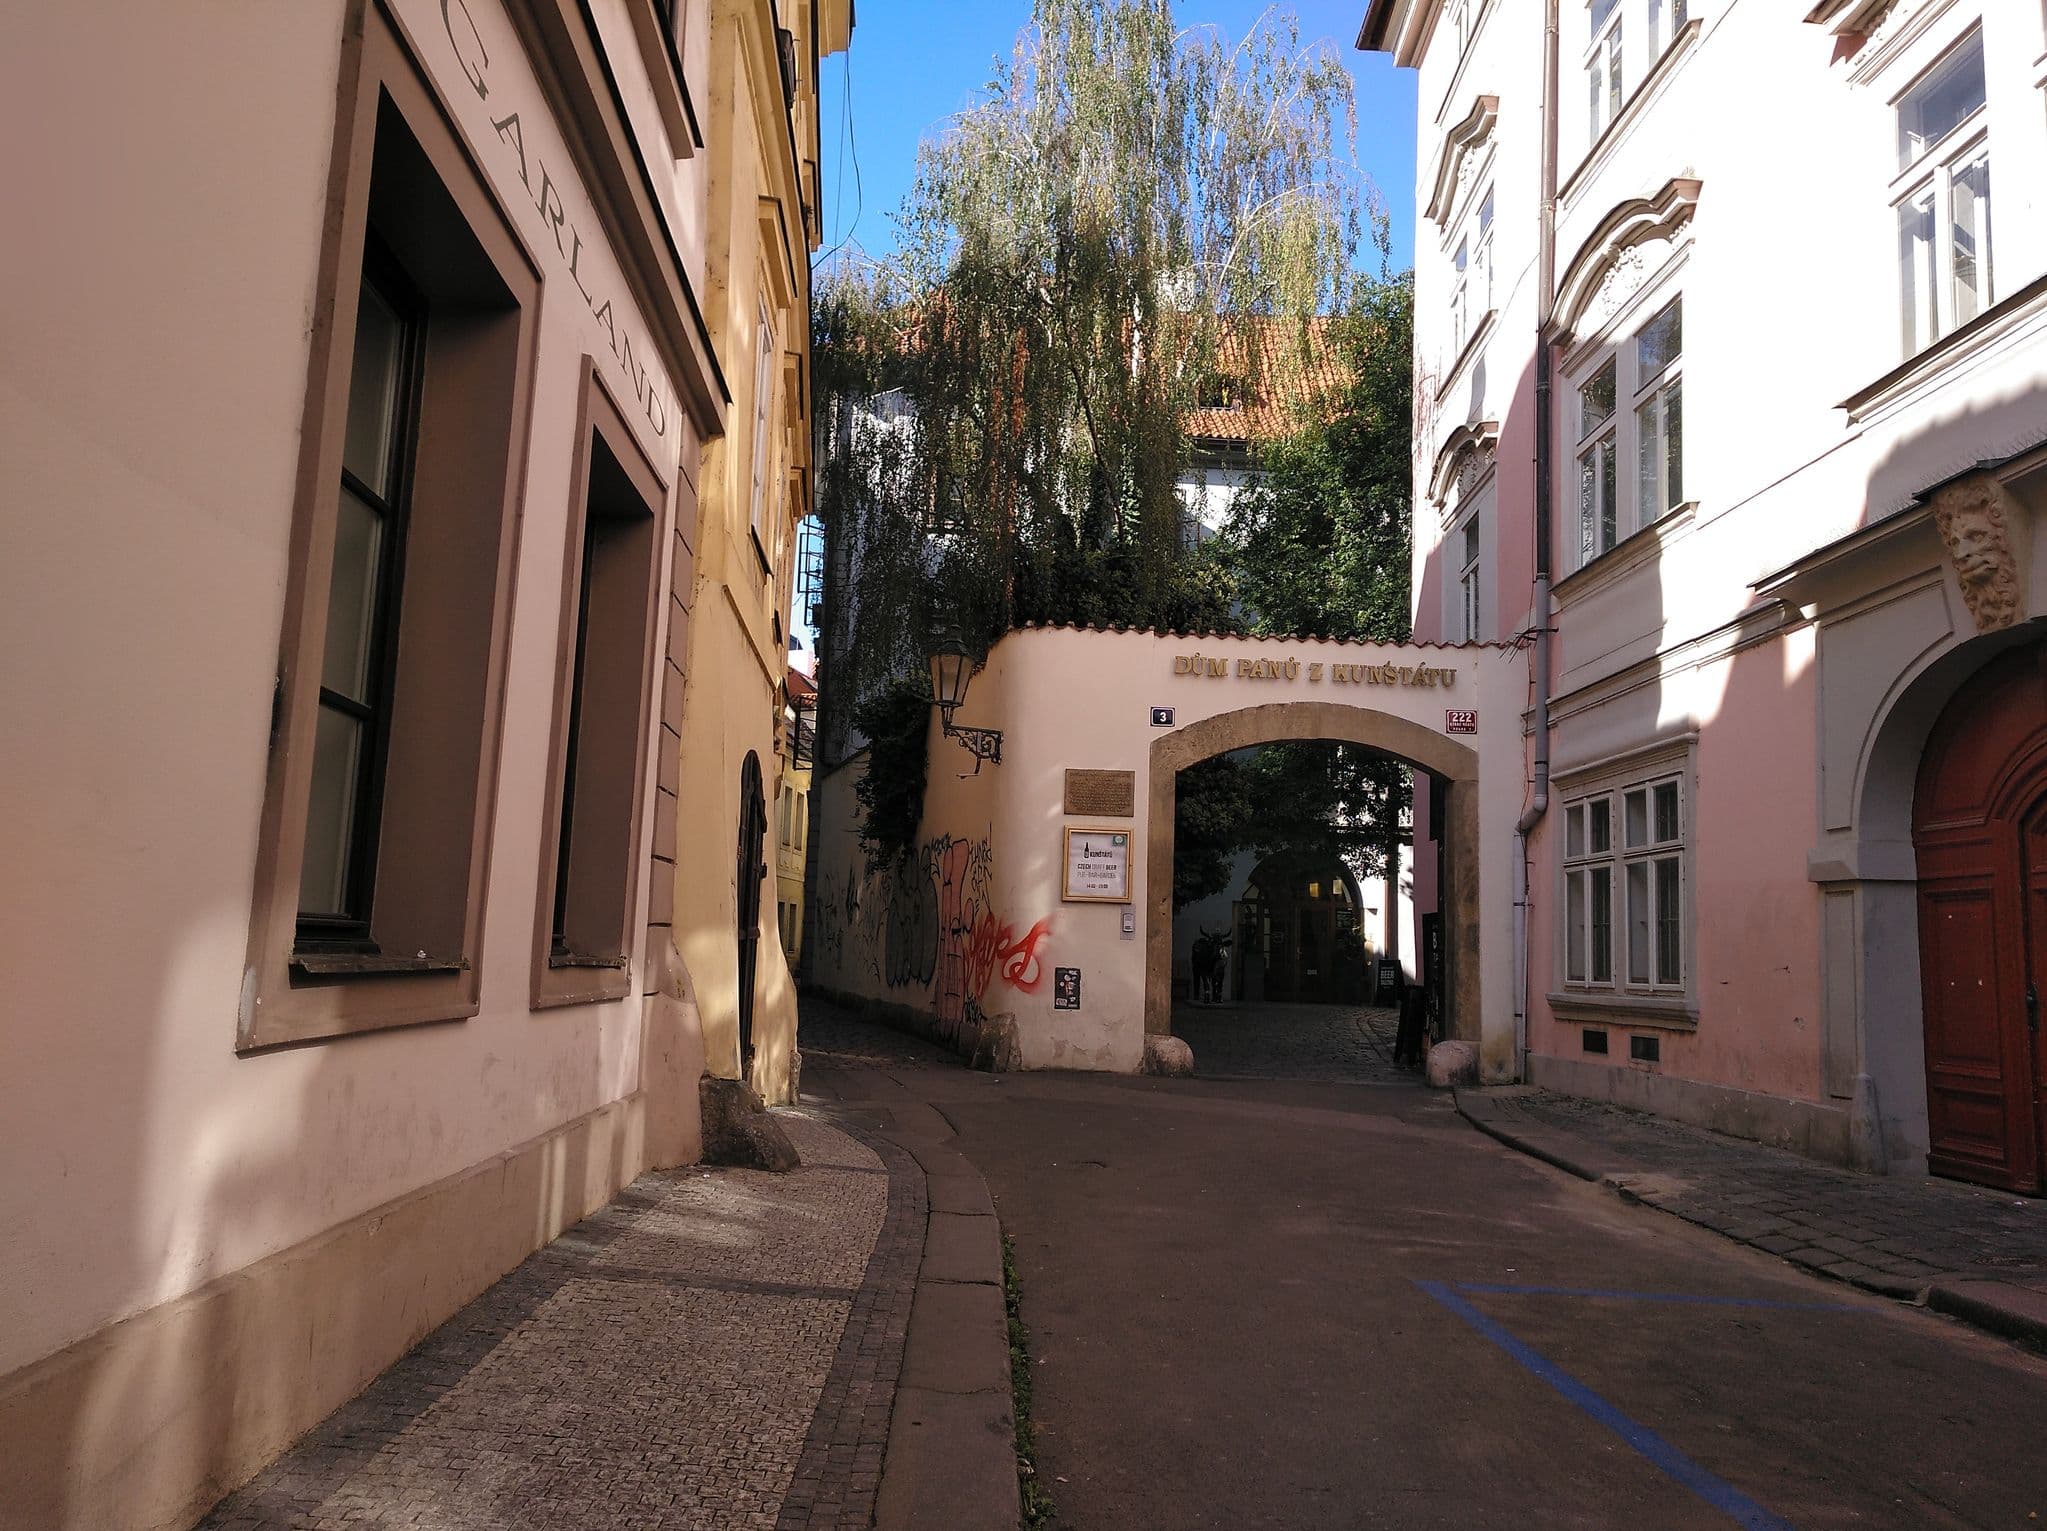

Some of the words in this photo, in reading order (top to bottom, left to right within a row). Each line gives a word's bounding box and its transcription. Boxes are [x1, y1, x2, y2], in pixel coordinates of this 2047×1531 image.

[440, 0, 665, 436] GARLAND
[1174, 652, 1229, 677] DŮM
[1309, 662, 1324, 681] Z
[1160, 711, 1167, 722] 3
[1452, 712, 1473, 723] 222
